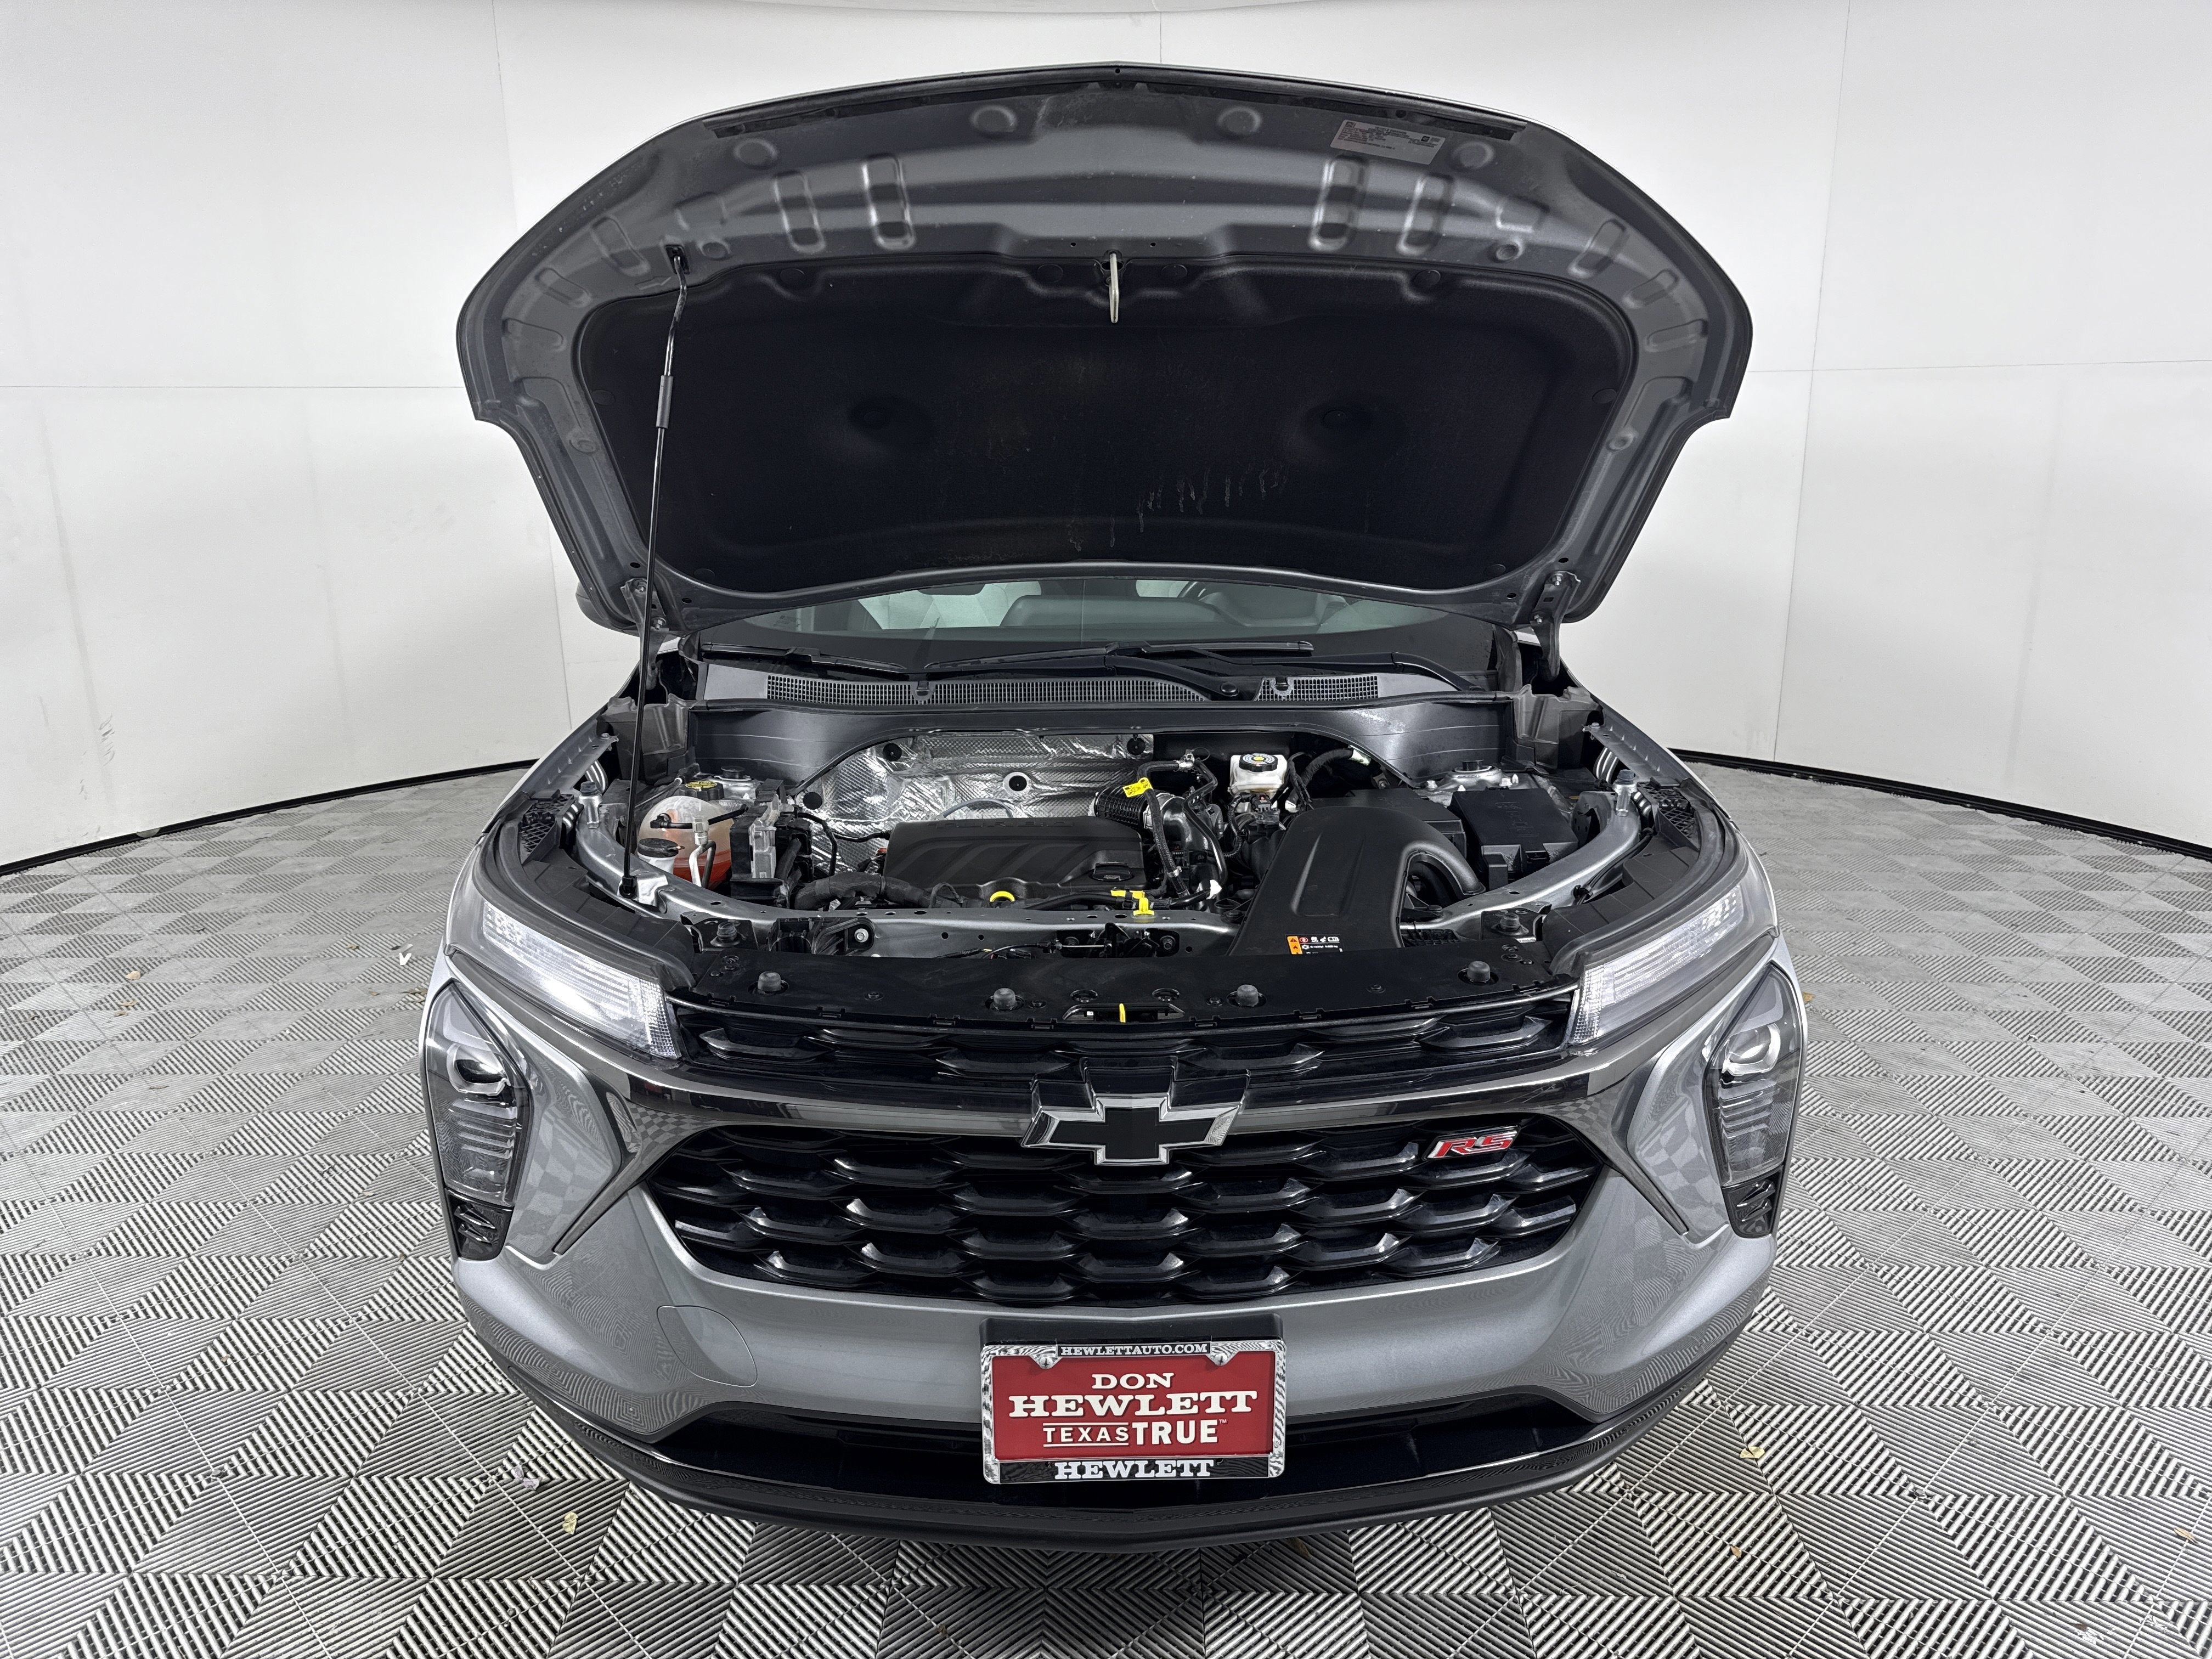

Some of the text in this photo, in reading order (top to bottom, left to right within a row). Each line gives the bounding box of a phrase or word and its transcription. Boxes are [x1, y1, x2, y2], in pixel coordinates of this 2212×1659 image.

[1427, 1131, 1518, 1159] RS
[1060, 1344, 1207, 1356] HEWLETTAUTO.COM
[1091, 1372, 1175, 1390] DON
[1008, 1390, 1257, 1417] HEWLETT
[1054, 1459, 1214, 1480] HEWLETT
